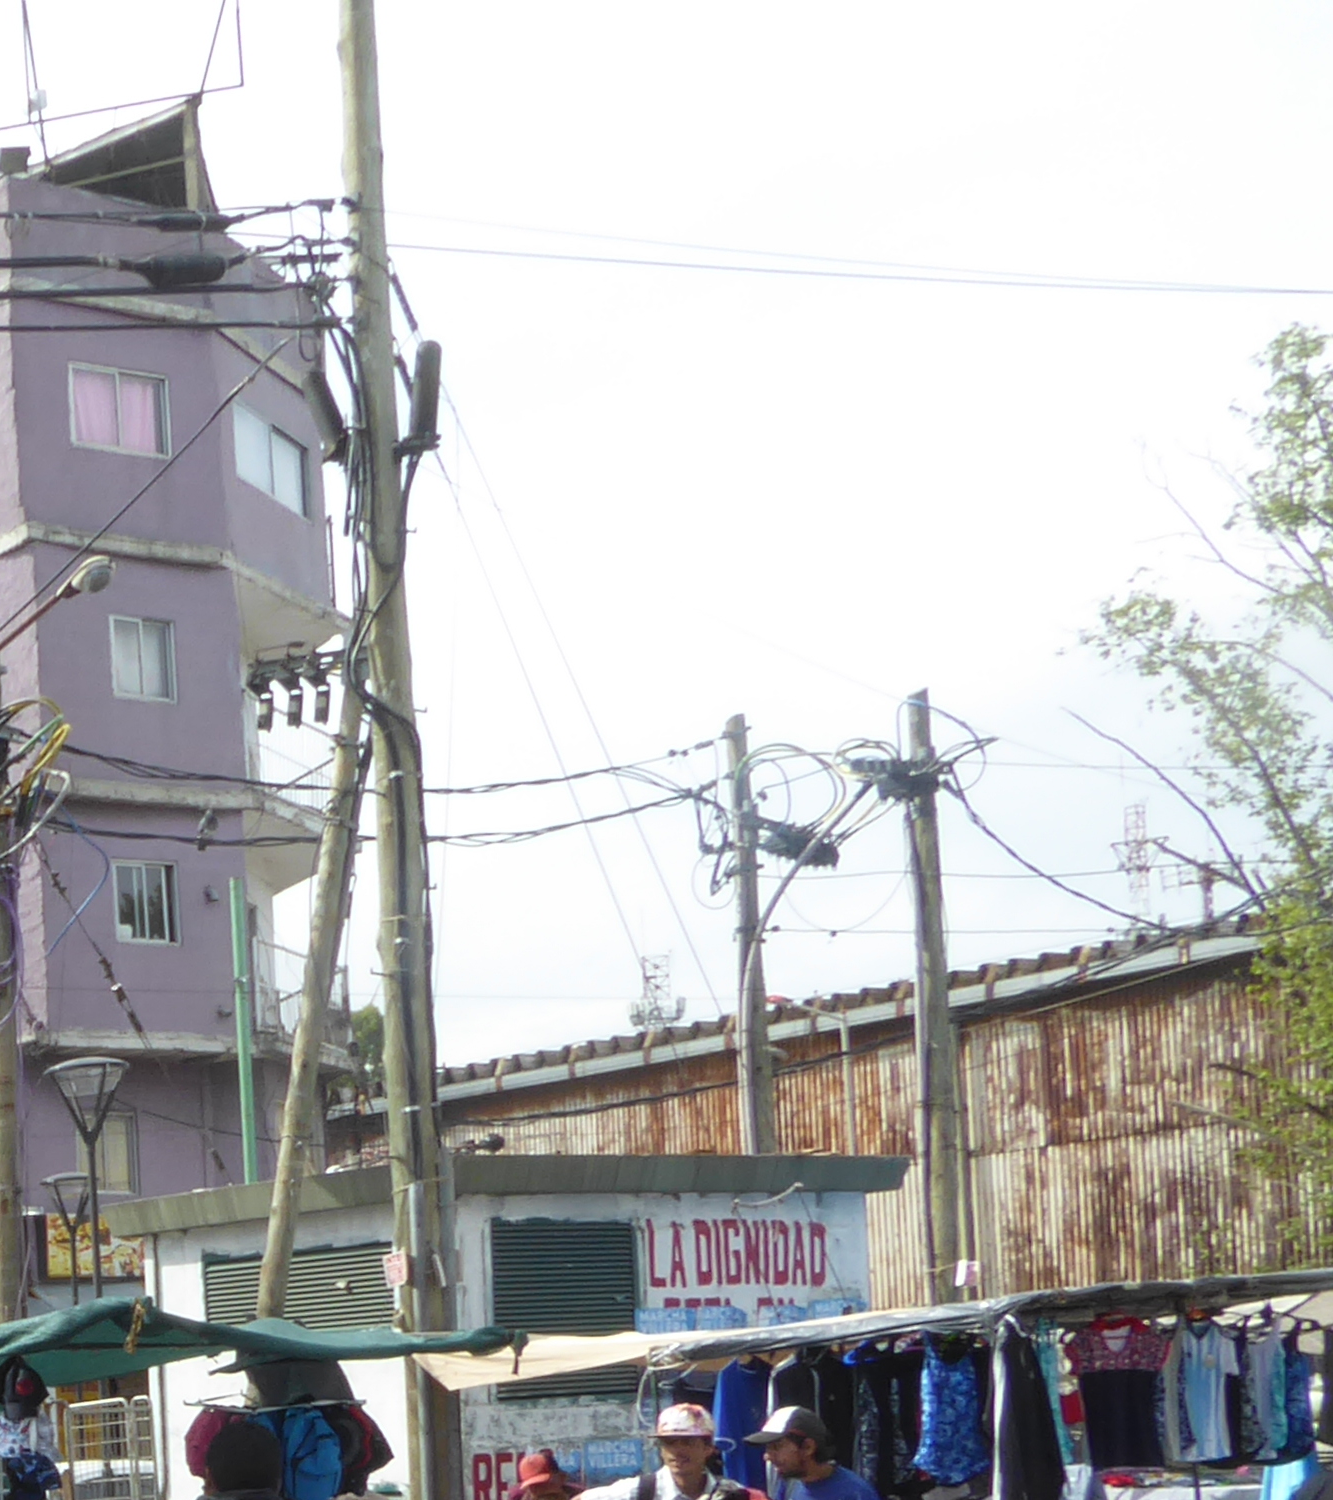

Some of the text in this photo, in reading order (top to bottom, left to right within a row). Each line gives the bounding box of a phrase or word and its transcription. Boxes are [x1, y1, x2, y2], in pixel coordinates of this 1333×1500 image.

[645, 1218, 827, 1288] LA DIGNIDAD
[587, 1440, 637, 1454] MARCHA
[587, 1454, 638, 1468] VILLERA
